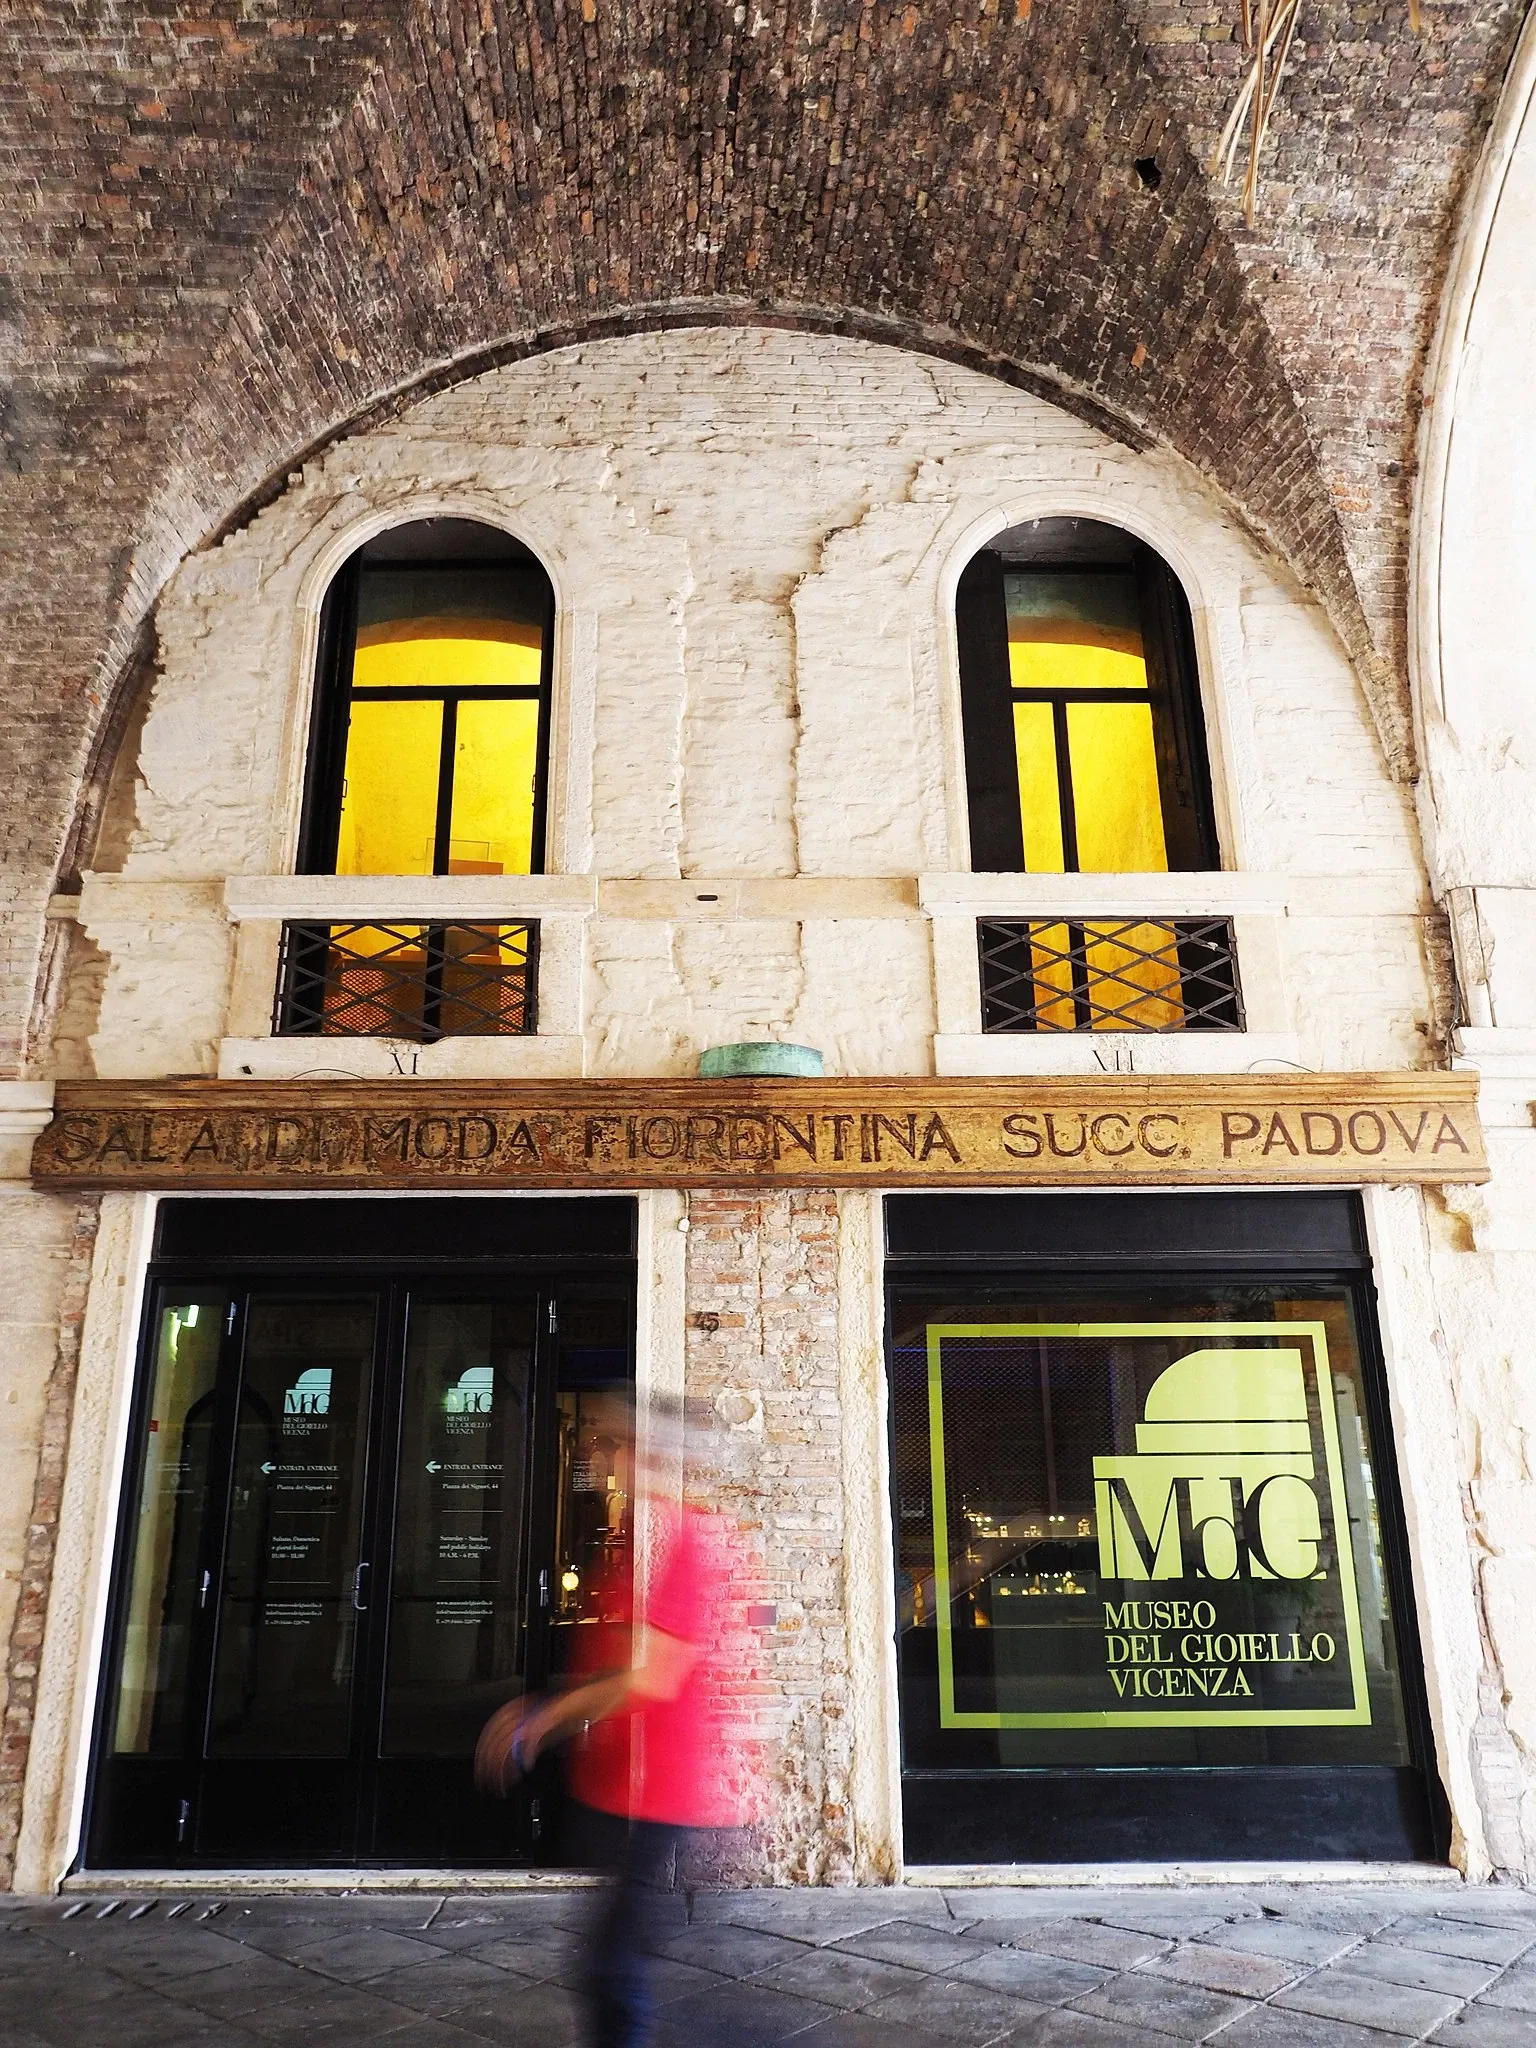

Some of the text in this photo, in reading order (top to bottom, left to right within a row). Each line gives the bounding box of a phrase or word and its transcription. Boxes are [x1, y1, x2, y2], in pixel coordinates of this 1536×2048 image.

[387, 1053, 418, 1075] XI
[55, 1117, 223, 1163] SALA
[362, 1116, 541, 1162] MODA
[585, 1112, 962, 1163] FIORENTINA
[1220, 1110, 1469, 1157] PADOVA
[1103, 1601, 1216, 1629] MUSEO
[1105, 1633, 1335, 1663] DEL GIOIELLO
[1108, 1668, 1254, 1697] VICENZA
